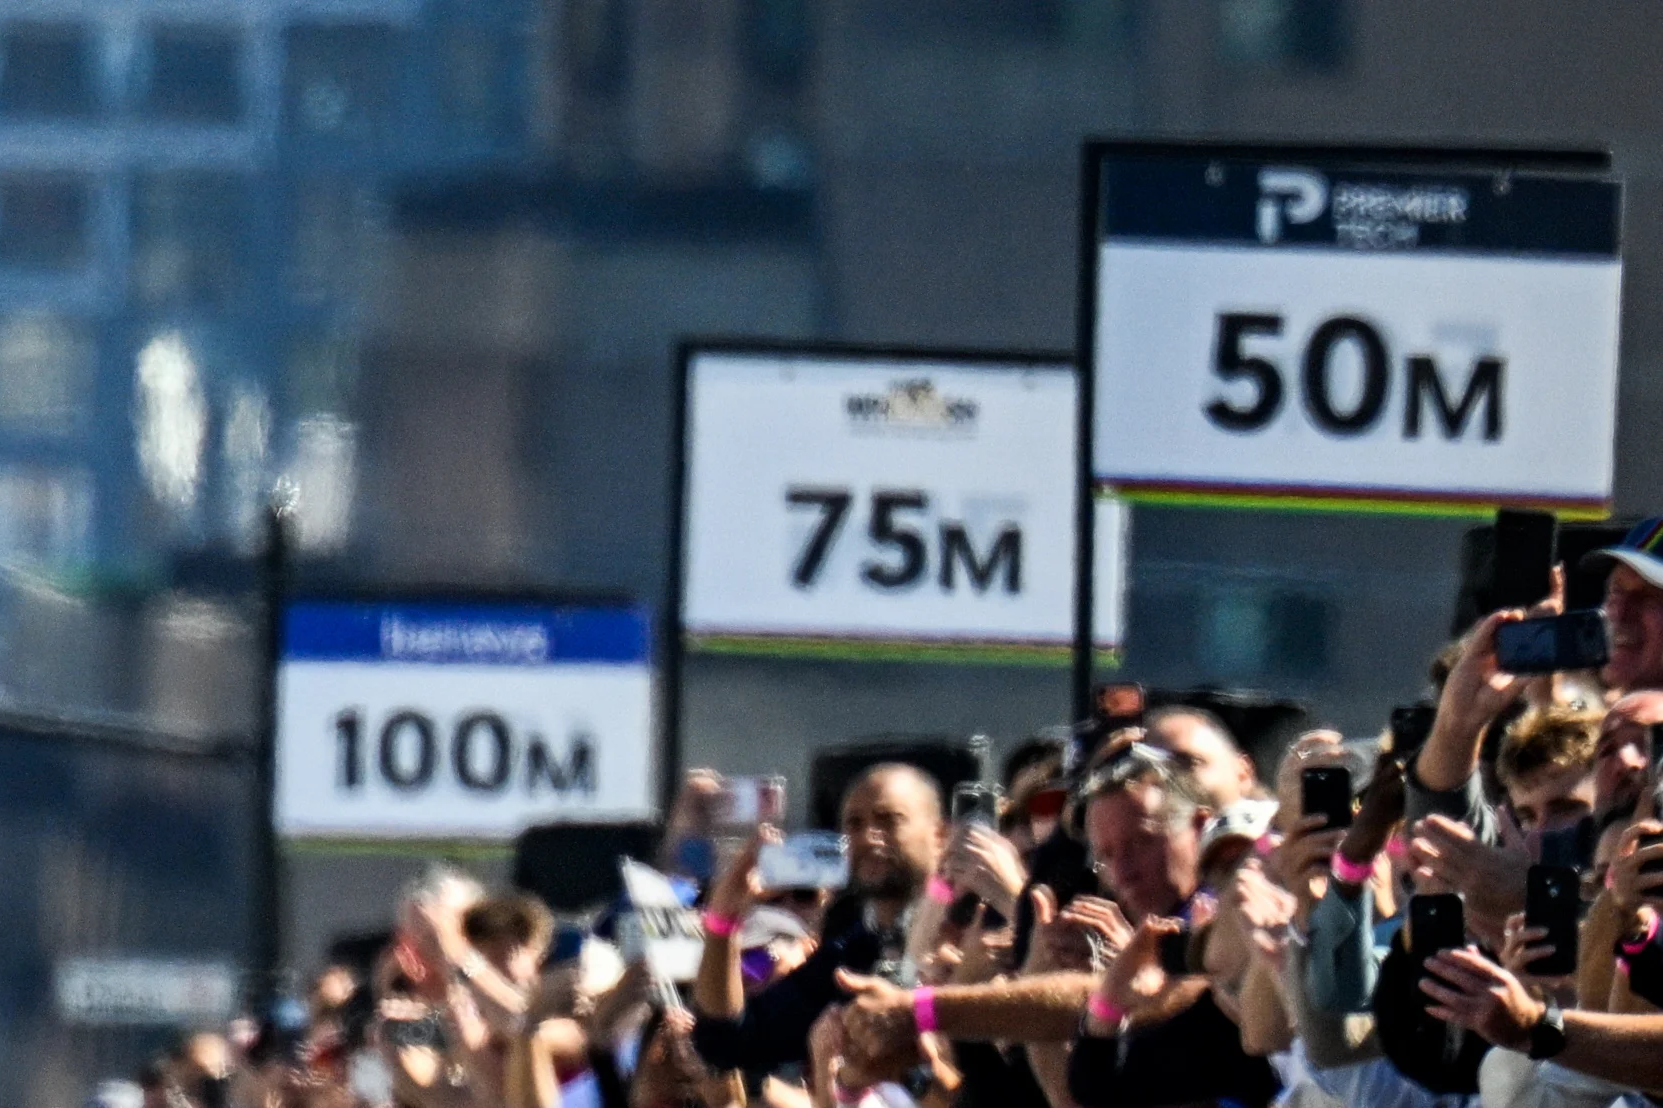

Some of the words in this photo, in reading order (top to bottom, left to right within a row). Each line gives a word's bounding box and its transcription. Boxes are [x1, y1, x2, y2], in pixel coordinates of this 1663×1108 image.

[1205, 312, 1508, 442] 50M
[786, 487, 1023, 594] 75M
[335, 706, 596, 797] 100M
